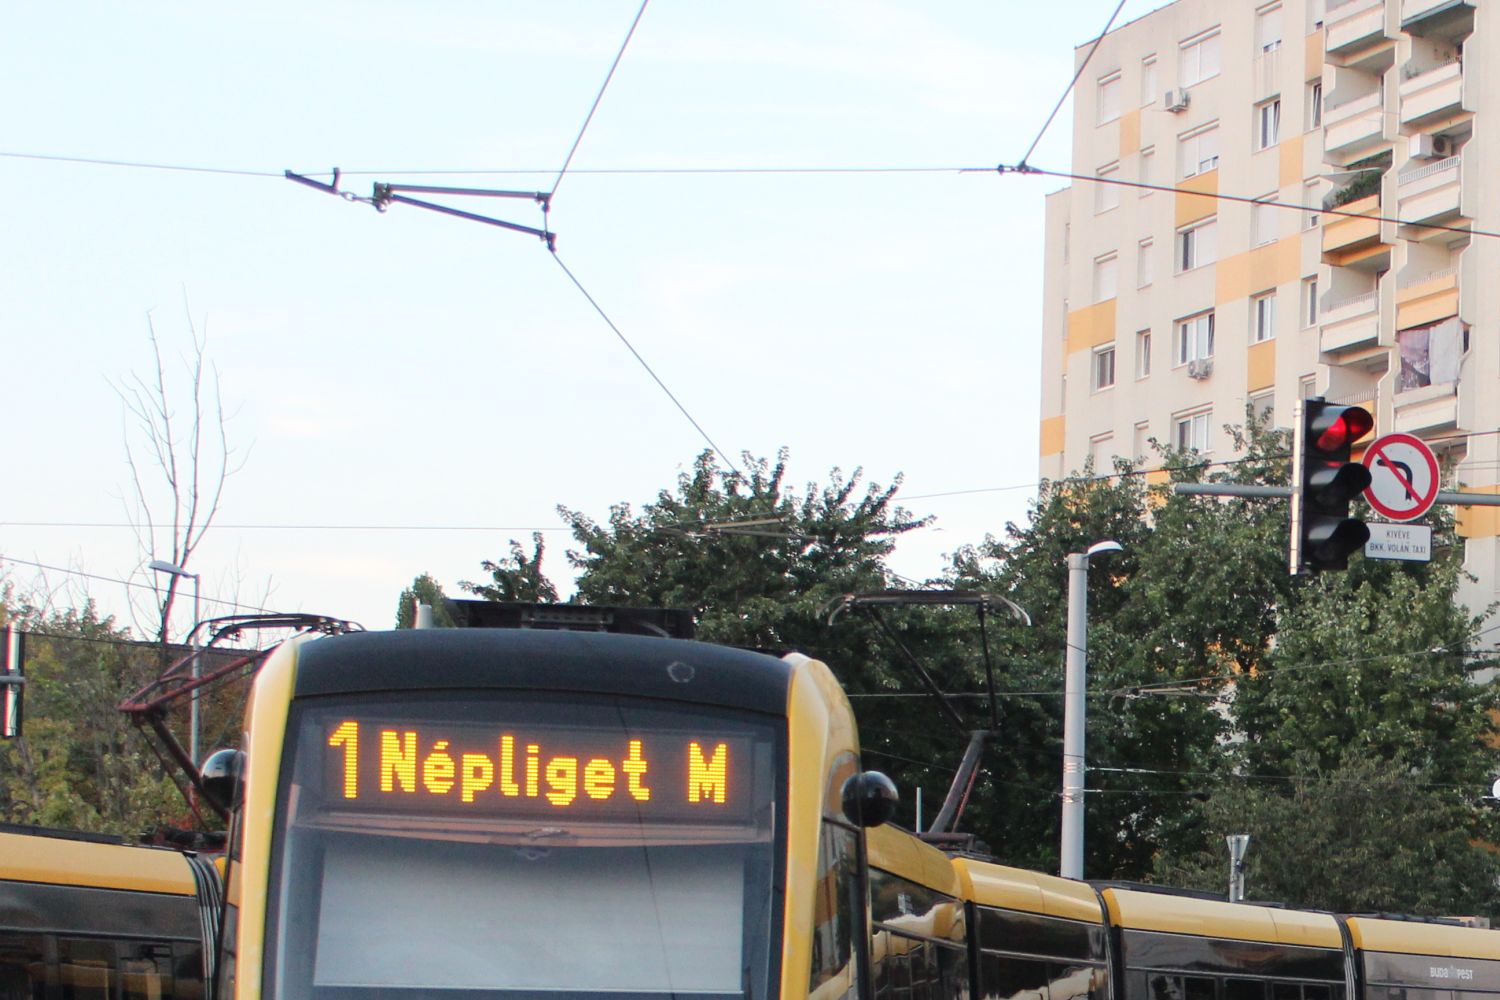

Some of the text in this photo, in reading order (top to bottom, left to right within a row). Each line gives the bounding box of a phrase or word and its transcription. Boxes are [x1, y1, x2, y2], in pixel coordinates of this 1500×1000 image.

[328, 720, 727, 806] 1 Népliget M
